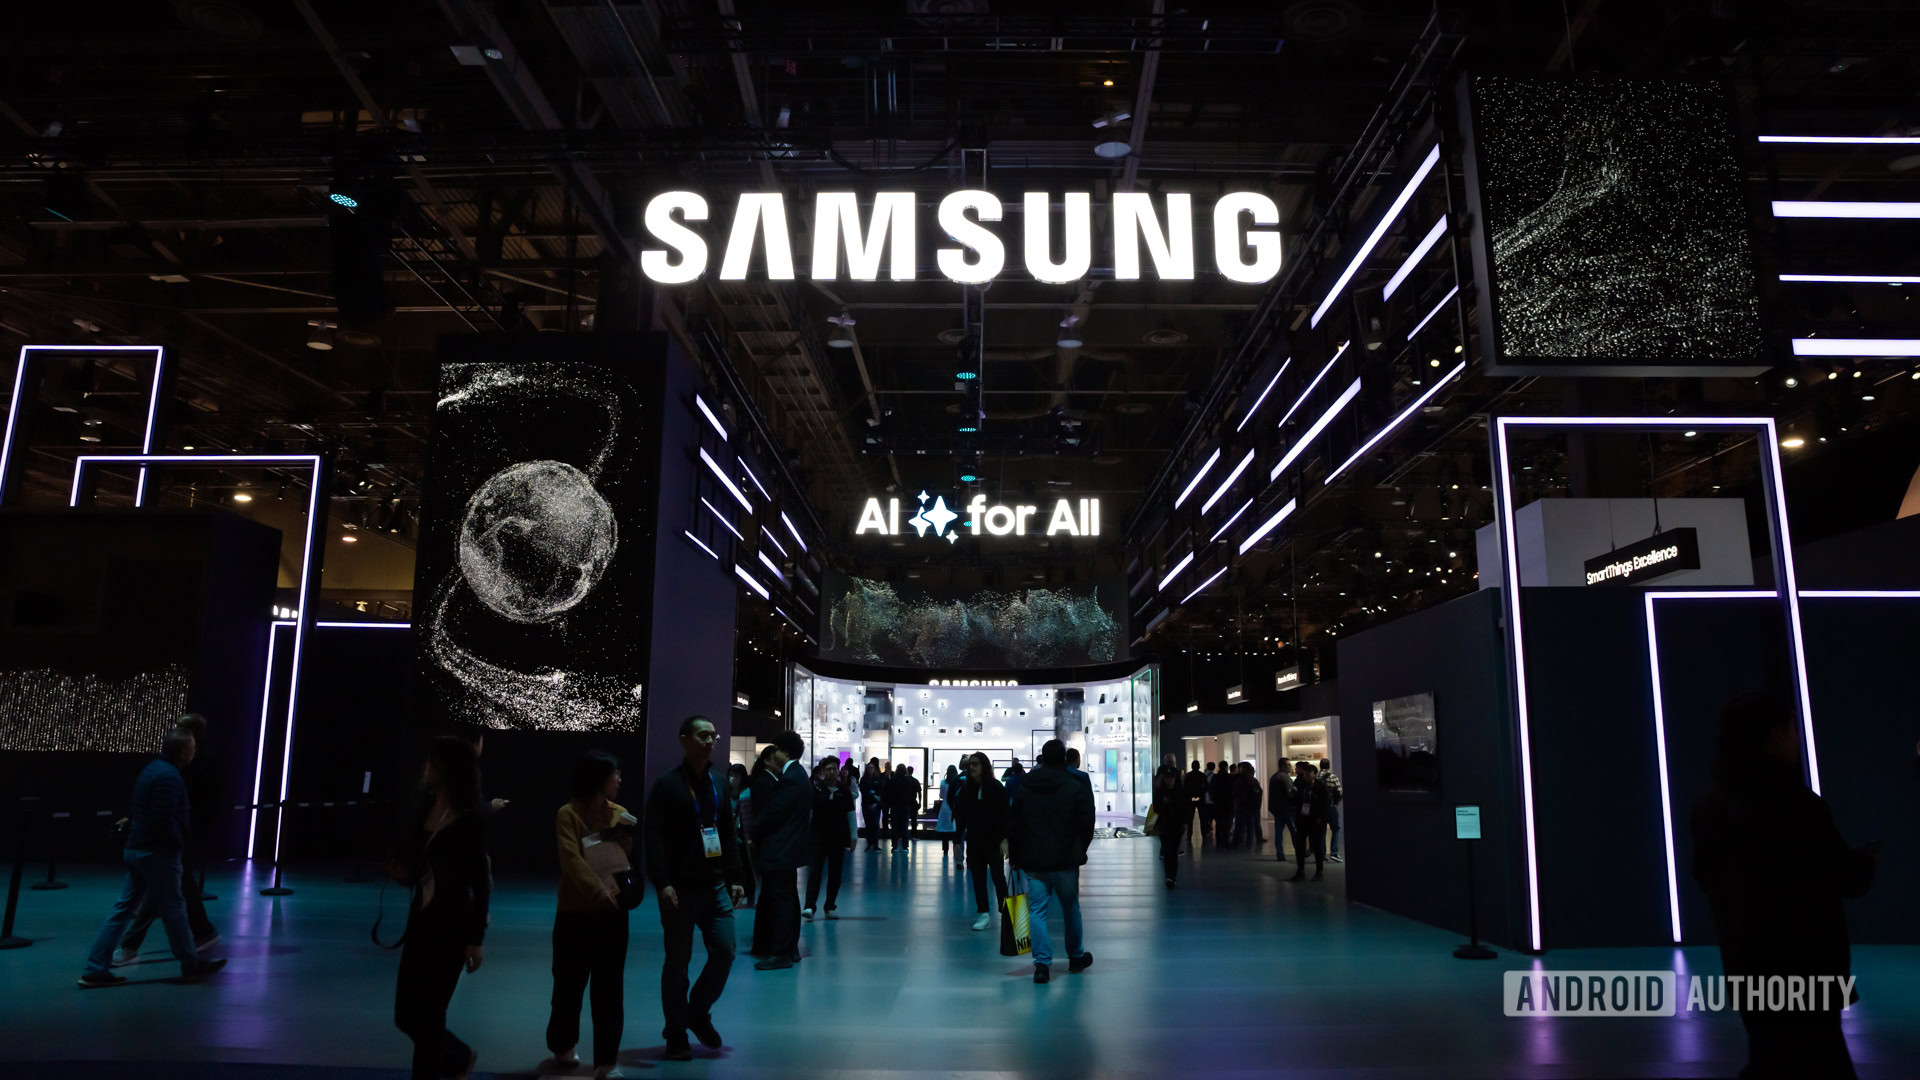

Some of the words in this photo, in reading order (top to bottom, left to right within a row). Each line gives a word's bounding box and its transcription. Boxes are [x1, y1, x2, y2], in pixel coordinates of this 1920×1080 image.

[641, 190, 1281, 284] SAMSUNG
[856, 498, 899, 535] AI
[967, 494, 1036, 536] for
[1047, 498, 1100, 536] All
[1587, 561, 1633, 585] SmartThings
[1633, 545, 1678, 570] Excellence
